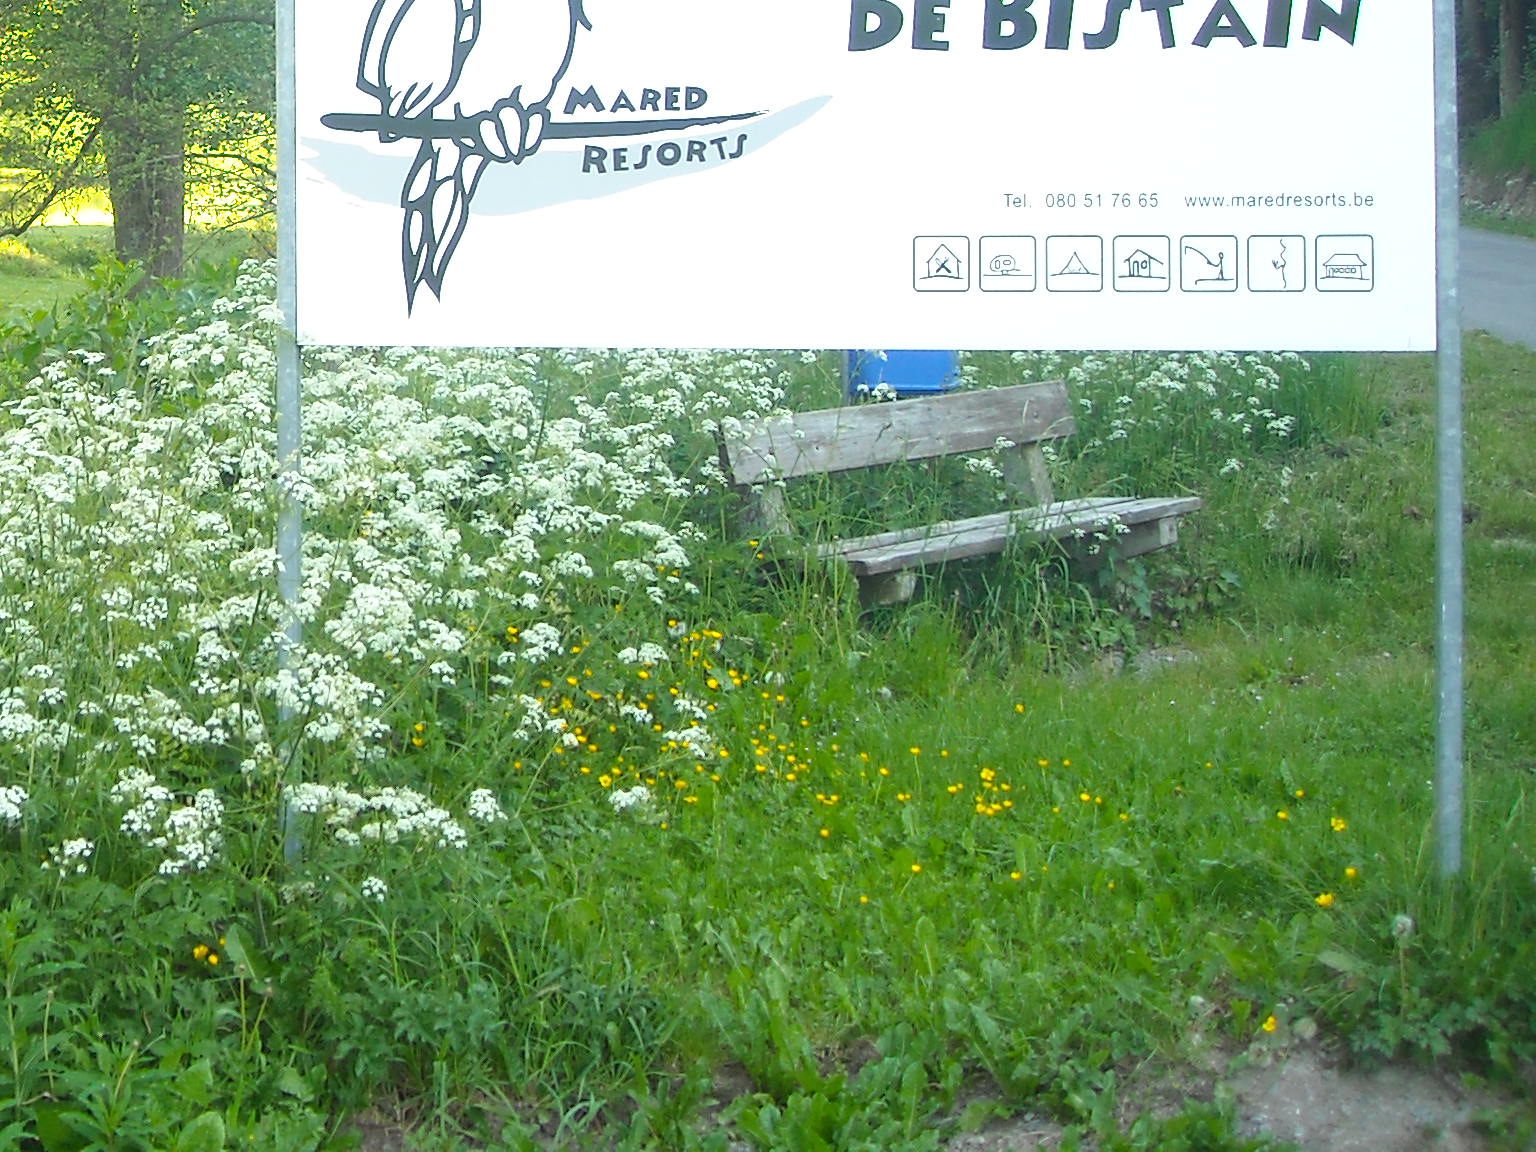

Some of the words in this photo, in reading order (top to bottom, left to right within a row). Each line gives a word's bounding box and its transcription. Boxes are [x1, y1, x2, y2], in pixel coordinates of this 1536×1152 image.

[563, 84, 709, 115] MARED
[581, 133, 748, 174] RESORTS
[1003, 193, 1032, 208] Tel.
[1045, 193, 1076, 208] 080
[1083, 193, 1102, 208] 51
[1111, 192, 1131, 208] 76
[1138, 192, 1159, 208] 65
[1184, 192, 1374, 208] www.maredresorts.be
